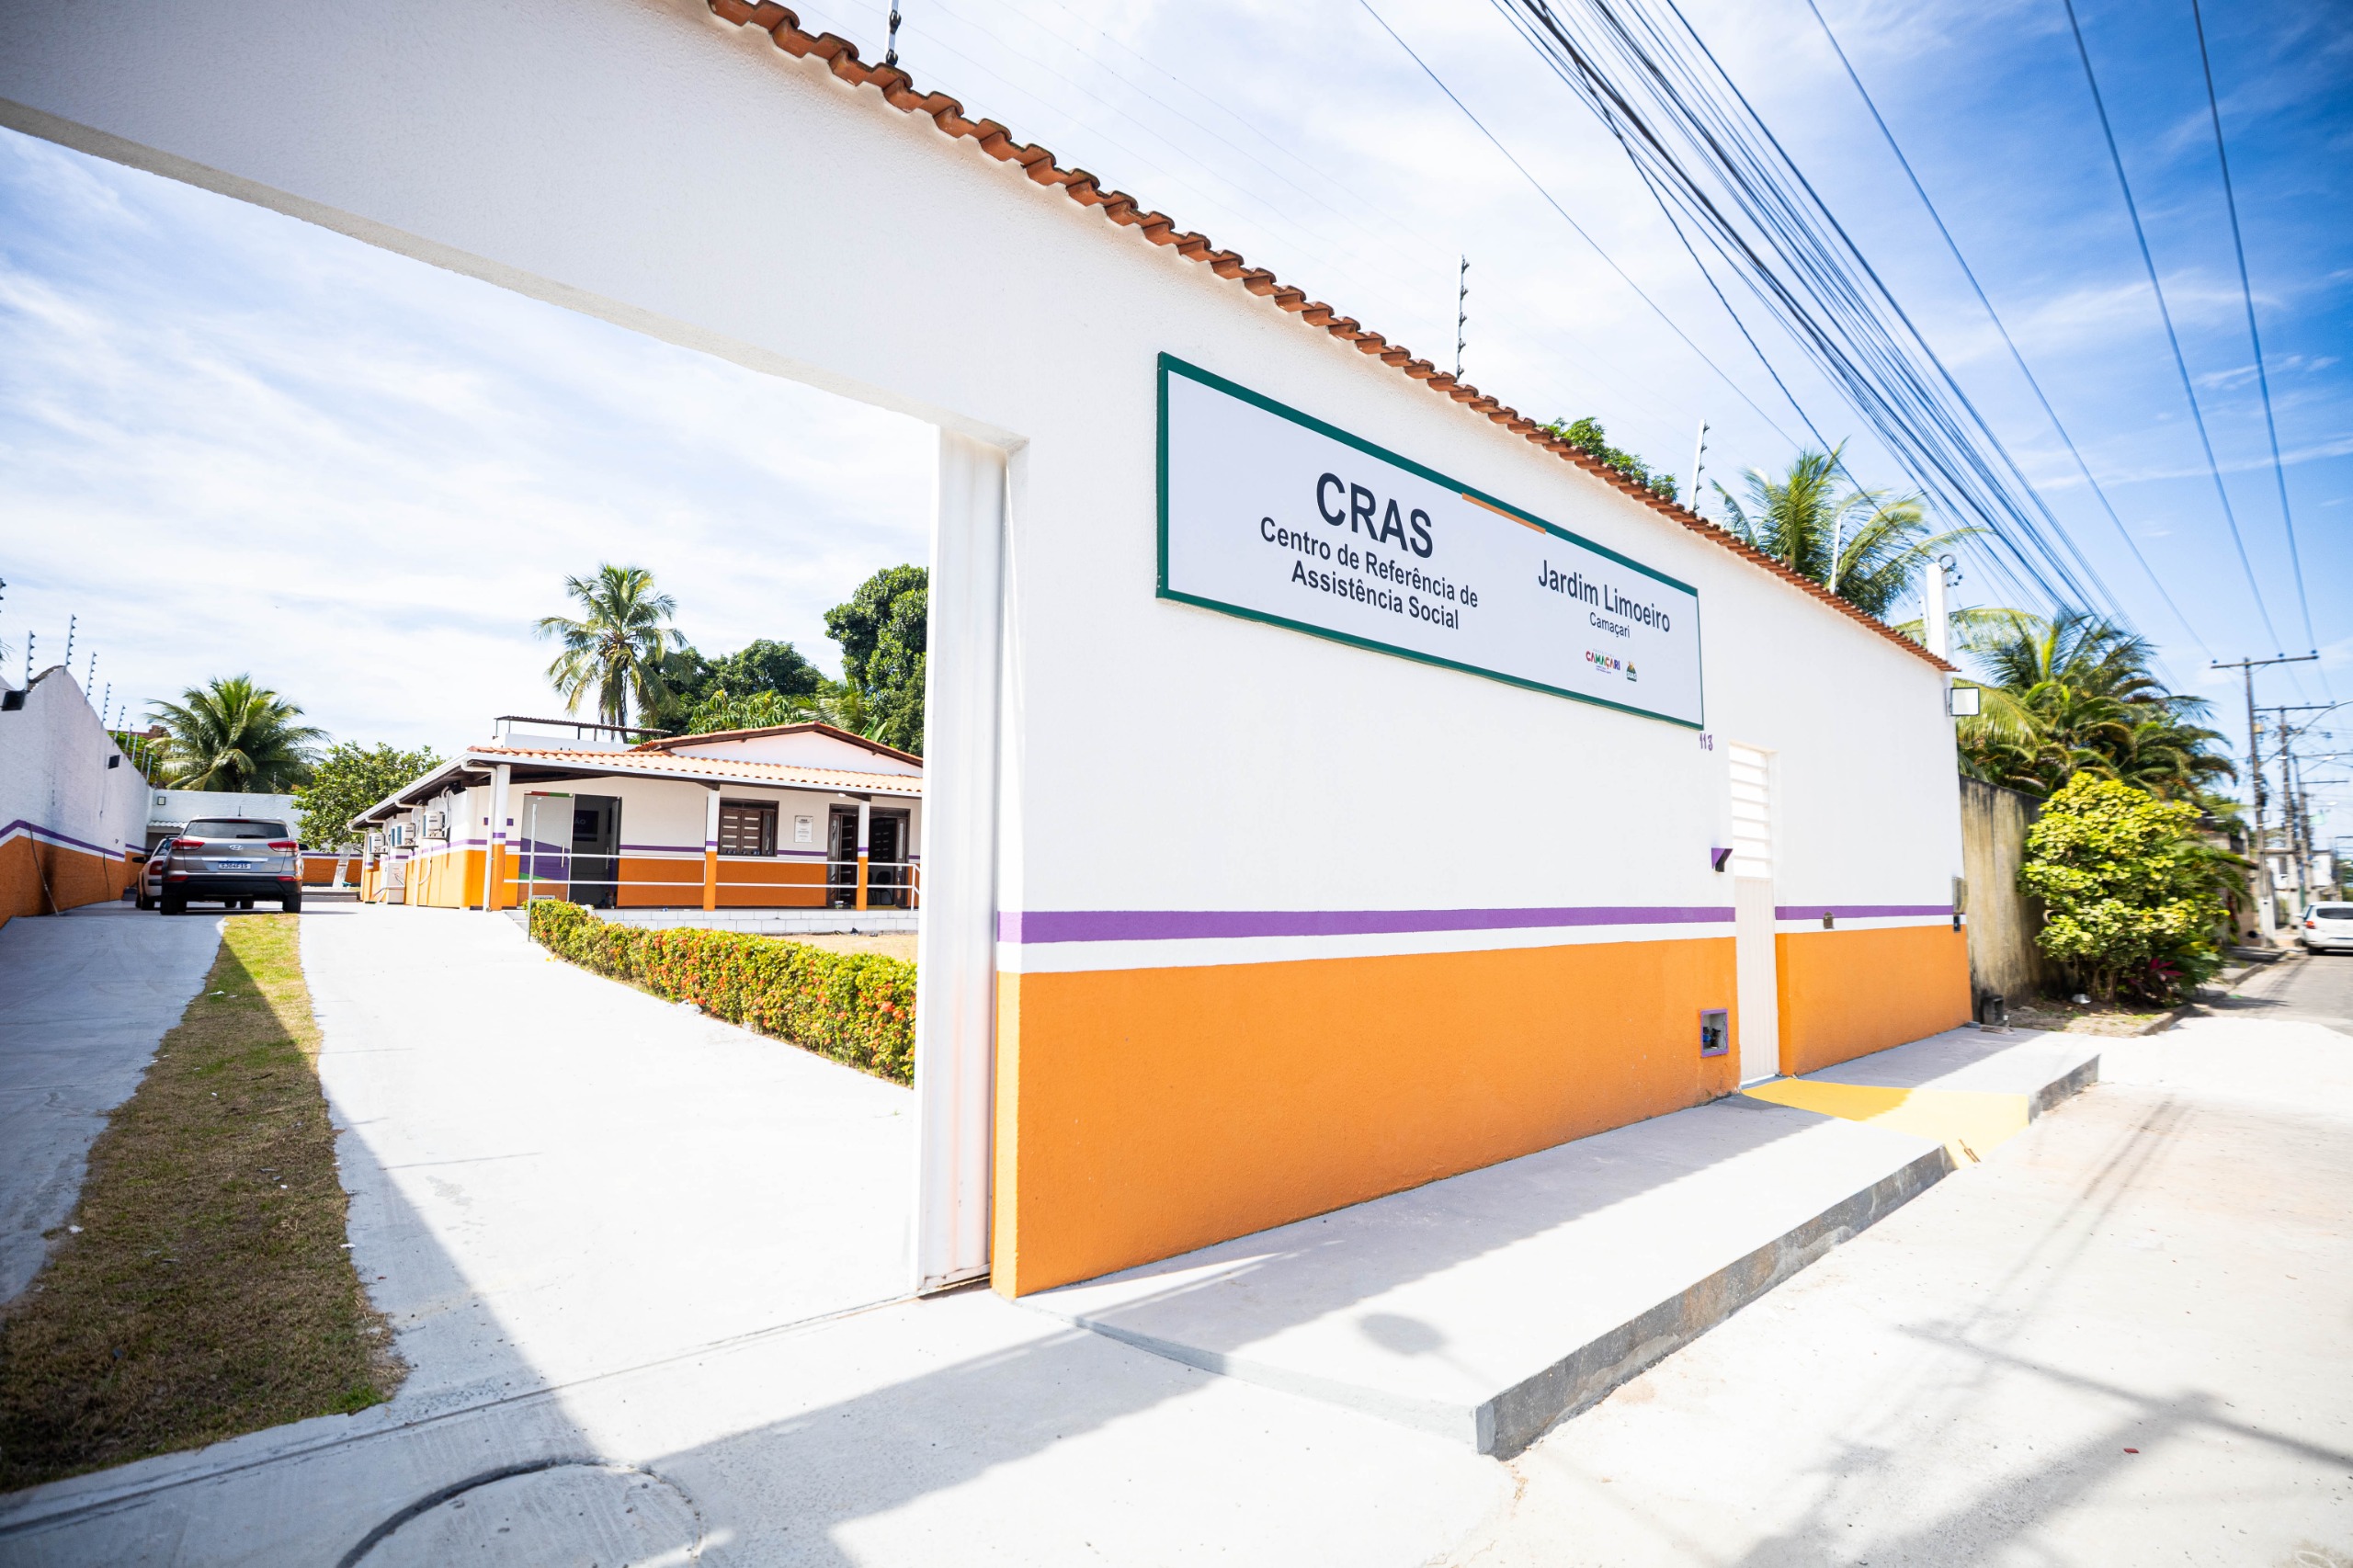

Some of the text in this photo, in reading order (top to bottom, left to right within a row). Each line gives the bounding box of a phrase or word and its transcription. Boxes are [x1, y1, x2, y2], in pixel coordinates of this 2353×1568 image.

[1316, 472, 1433, 559] CRAS
[1260, 517, 1478, 608] Centro de Referência de
[1291, 560, 1459, 630] Assistência Social
[1539, 560, 1670, 632] Jardim Limoeiro
[1590, 612, 1631, 638] Camaçari
[1586, 651, 1620, 671] CAMAÇARI
[1699, 733, 1713, 751] 113
